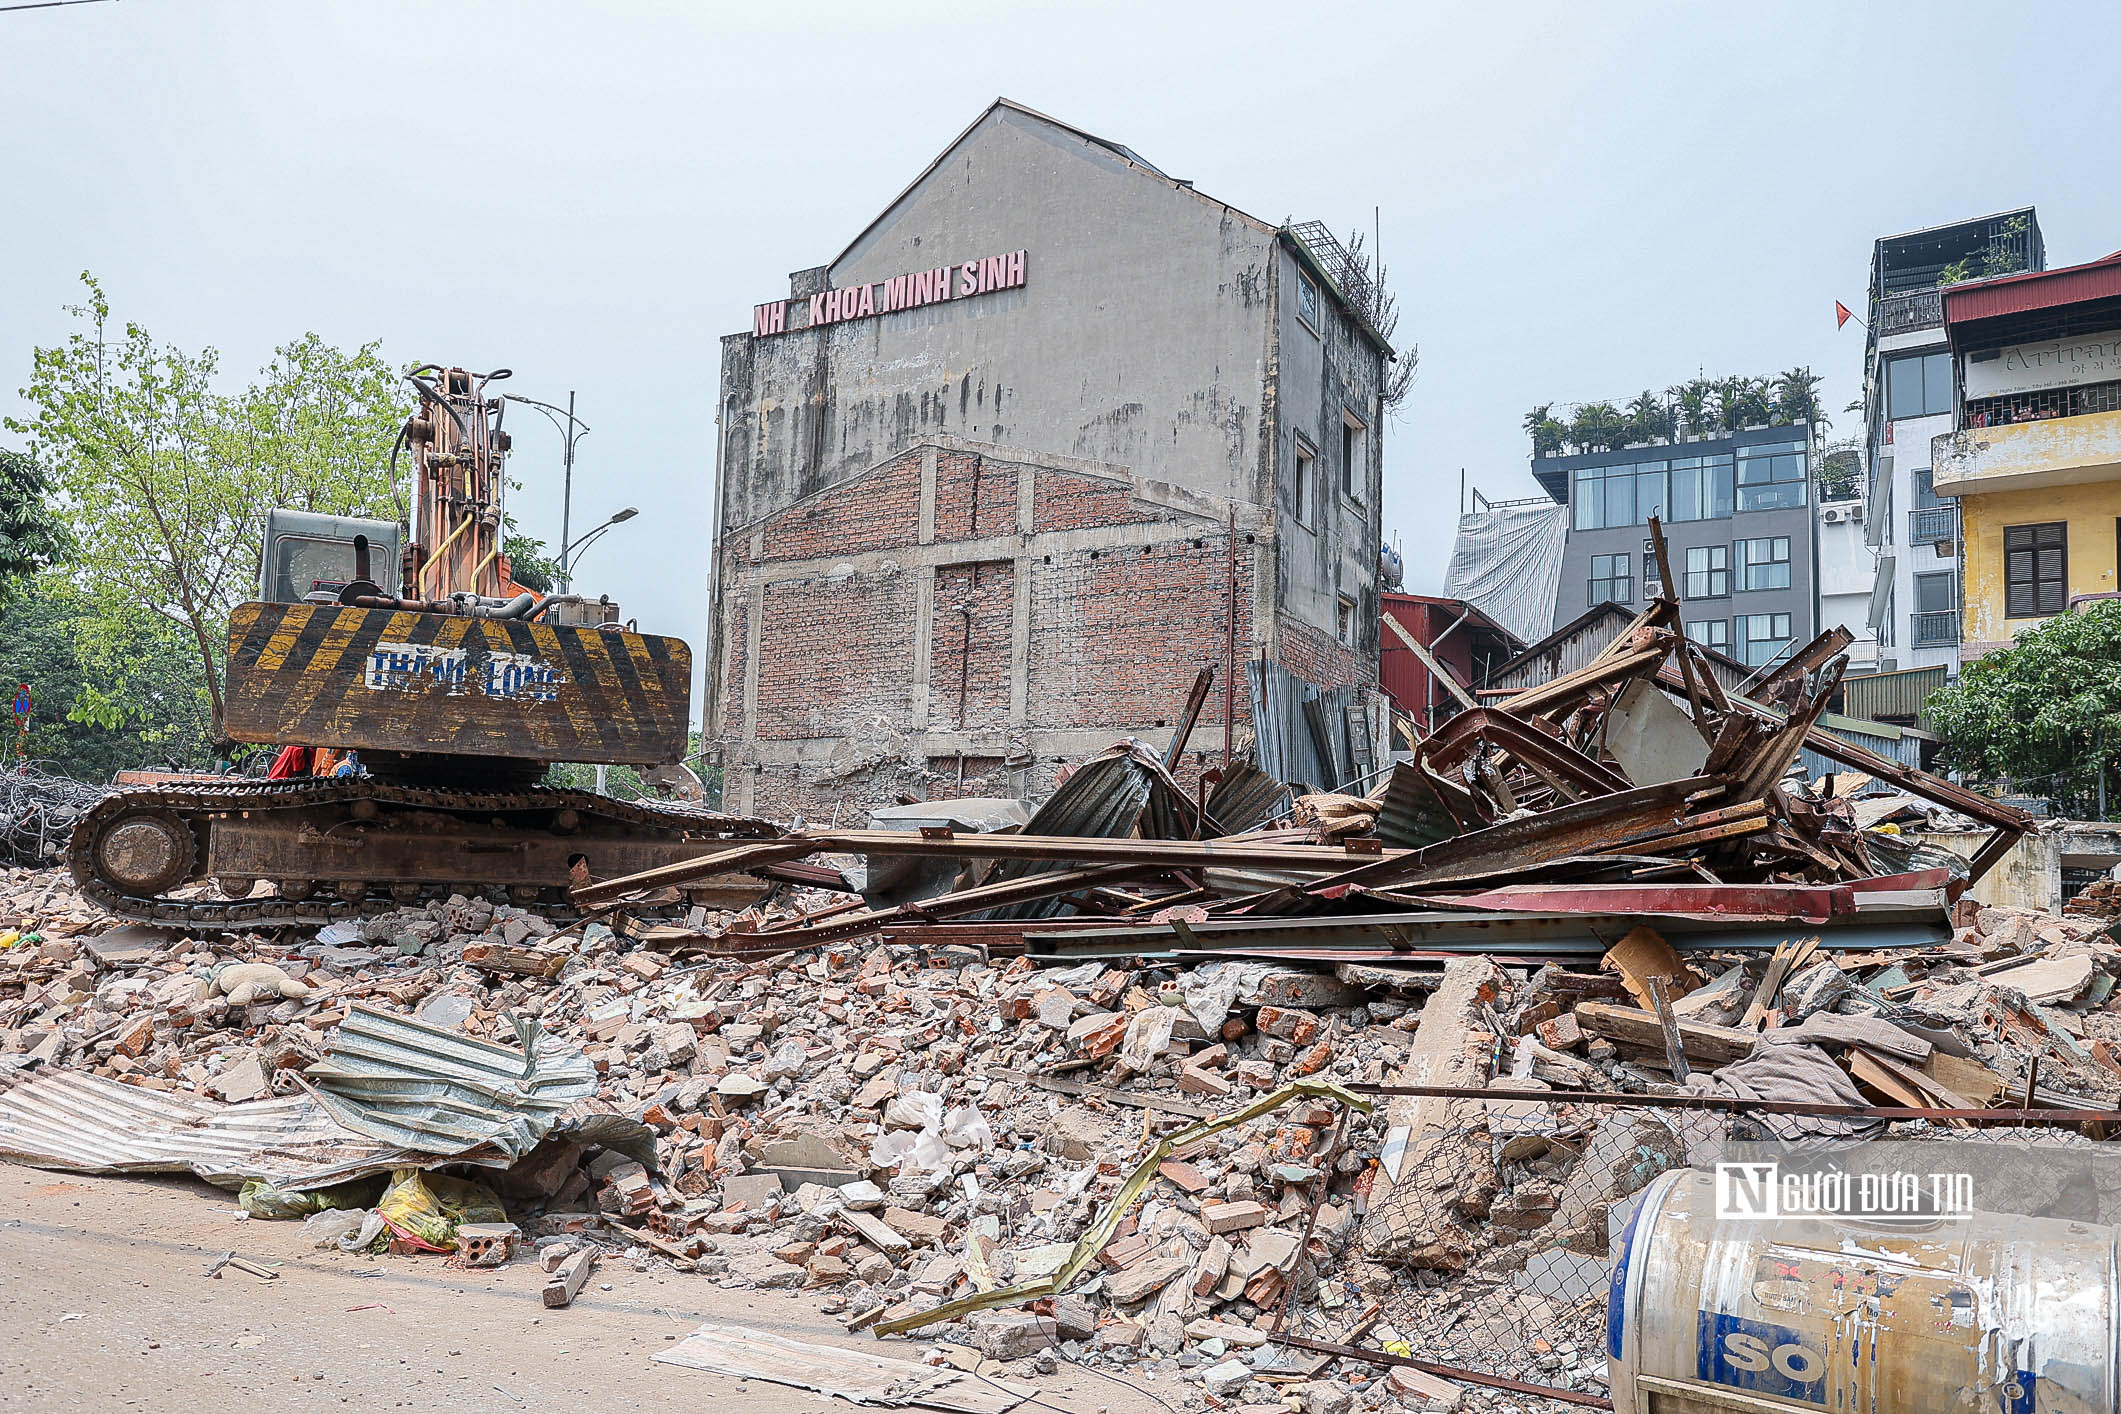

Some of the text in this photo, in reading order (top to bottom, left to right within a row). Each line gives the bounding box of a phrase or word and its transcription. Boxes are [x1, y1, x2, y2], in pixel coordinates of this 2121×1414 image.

[809, 283, 876, 326] KHOA
[882, 266, 953, 312] MINH
[959, 249, 1028, 296] SINH
